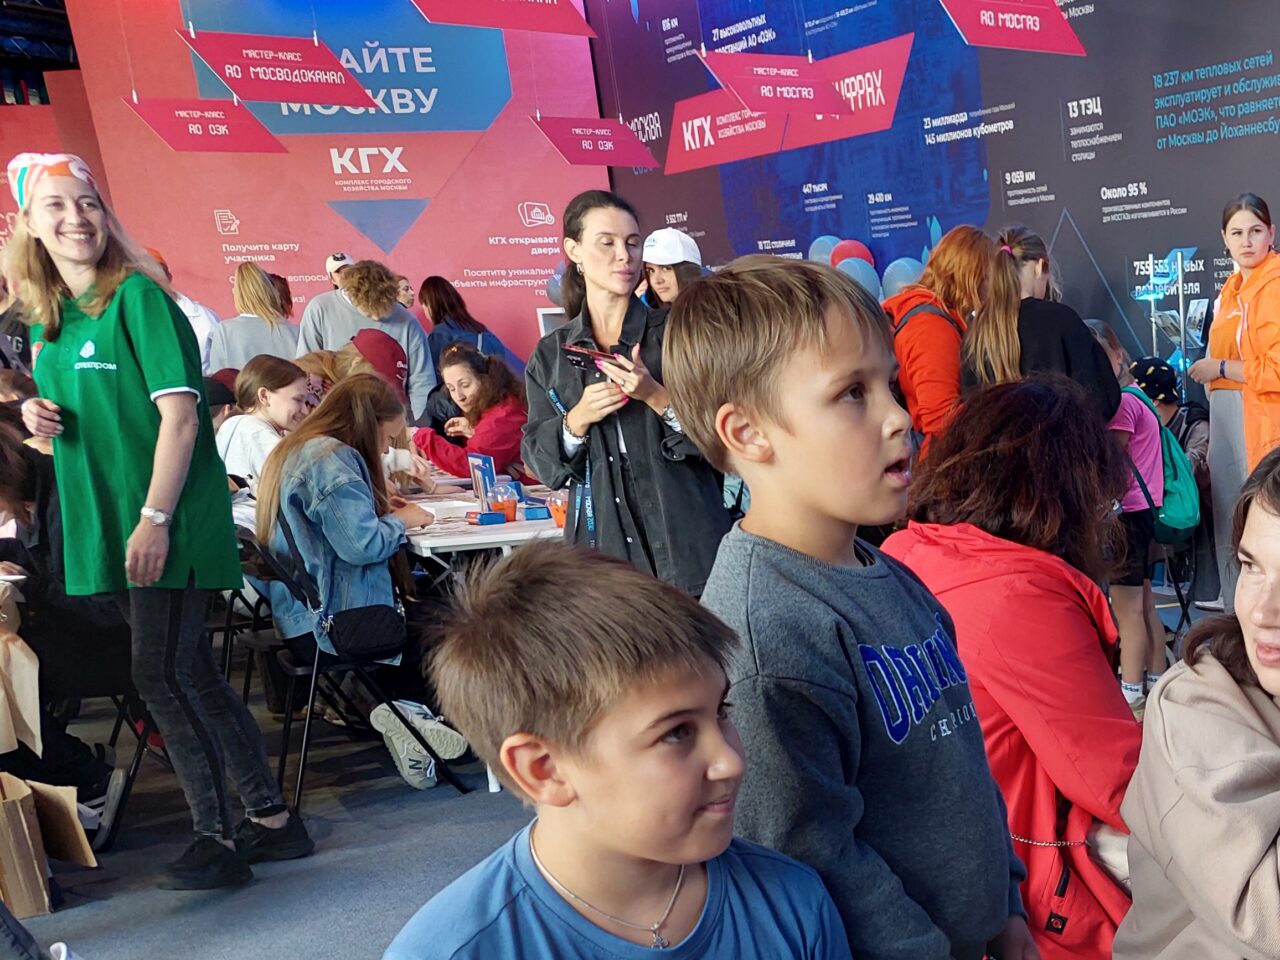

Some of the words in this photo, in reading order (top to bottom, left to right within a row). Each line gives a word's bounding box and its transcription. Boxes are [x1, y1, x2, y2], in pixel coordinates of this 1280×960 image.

[720, 14, 766, 39] высоковольтных
[980, 11, 994, 26] АО
[998, 14, 1040, 31] МОСГАЗ
[748, 34, 757, 47] АО
[243, 49, 302, 62] МАСТЕР-КЛАСС
[225, 65, 242, 79] АО
[249, 66, 345, 84] МОСВОДОКАНАЛ
[1153, 75, 1162, 88] 18
[1164, 70, 1179, 87] 237
[1181, 73, 1194, 83] км
[1195, 62, 1242, 80] тепловых
[1243, 50, 1273, 68] сетей
[761, 86, 773, 97] АО
[777, 86, 814, 99] МОСГАЗ
[1154, 85, 1222, 110] эксплуатирует
[1224, 84, 1231, 95] и
[1067, 102, 1078, 118] 13
[1079, 96, 1102, 116] ТЭЦ
[932, 111, 968, 128] миллиарда
[1156, 114, 1177, 130] ПАО
[1219, 105, 1236, 118] что
[682, 115, 715, 151] КГХ
[935, 127, 973, 143] миллионов
[972, 119, 1015, 138] кубометров
[1156, 137, 1167, 150] от
[1168, 130, 1204, 147] Москвы
[1206, 131, 1219, 144] до
[1070, 132, 1123, 149] теплоснабжением
[329, 147, 408, 174] КГХ
[1101, 184, 1127, 200] Около
[1128, 183, 1139, 197] 95
[222, 243, 270, 253] Получите
[272, 243, 299, 252] карту
[489, 237, 507, 245] КГХ
[509, 236, 559, 245] открывает
[224, 254, 276, 264] участника
[531, 247, 560, 255] двери
[463, 269, 506, 277] Посетите
